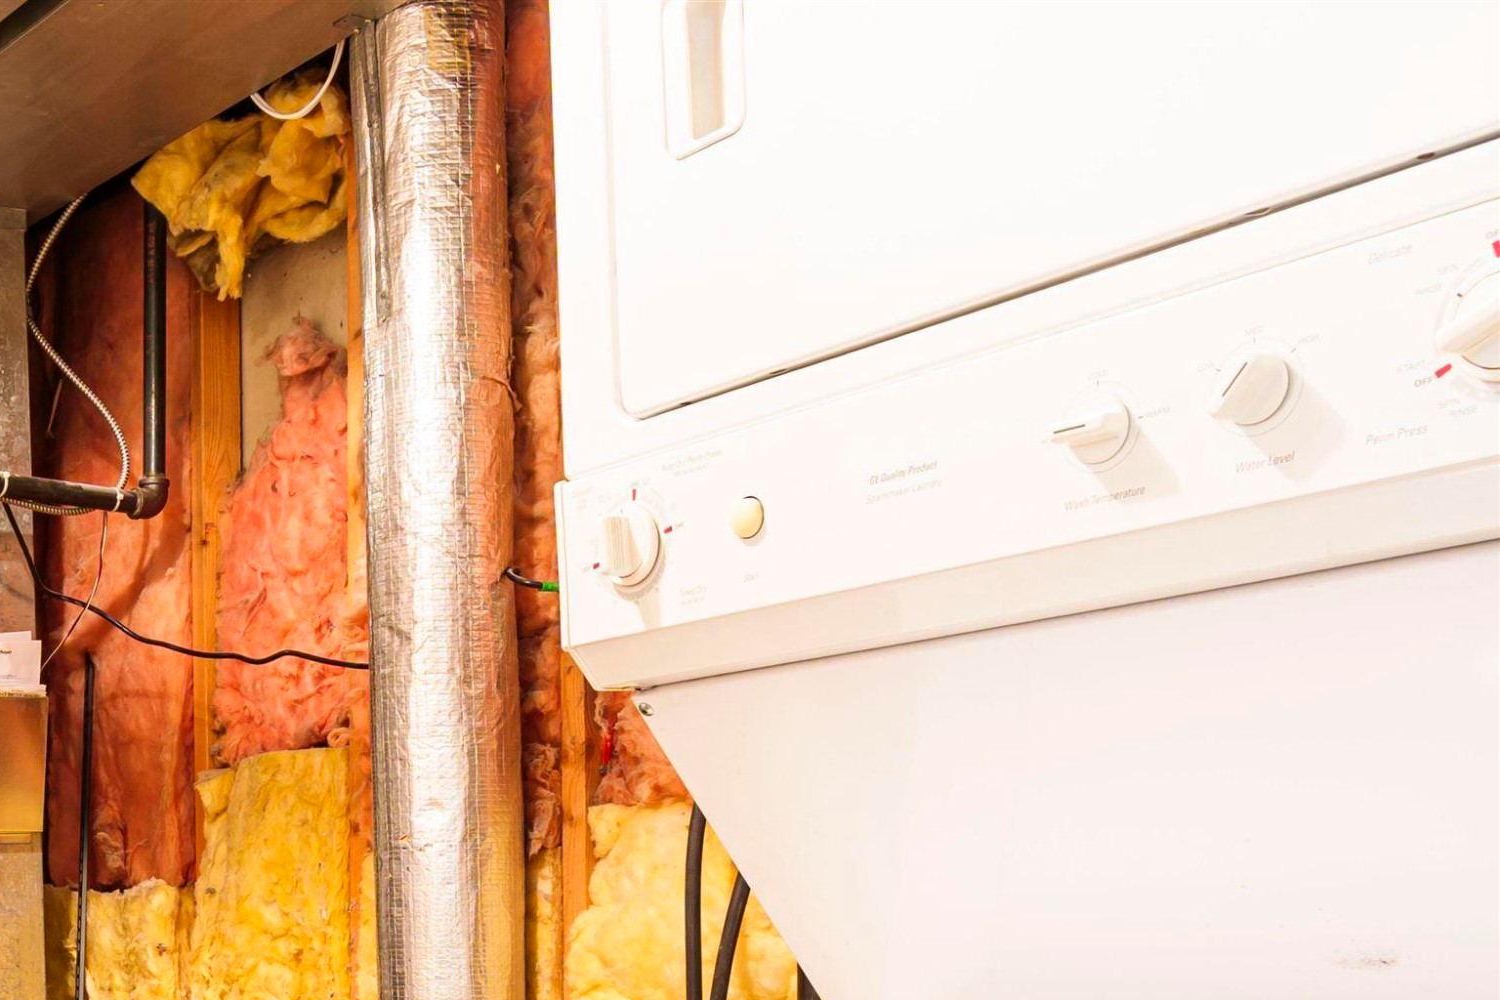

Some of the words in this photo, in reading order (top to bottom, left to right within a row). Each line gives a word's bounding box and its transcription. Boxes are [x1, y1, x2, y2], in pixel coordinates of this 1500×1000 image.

[1413, 375, 1432, 388] OFF
[1365, 431, 1395, 446] Perm
[1396, 424, 1429, 440] Press
[1267, 449, 1296, 467] Level
[881, 468, 906, 484] Quality
[907, 459, 938, 476] Product
[1092, 485, 1146, 504] Temperature
